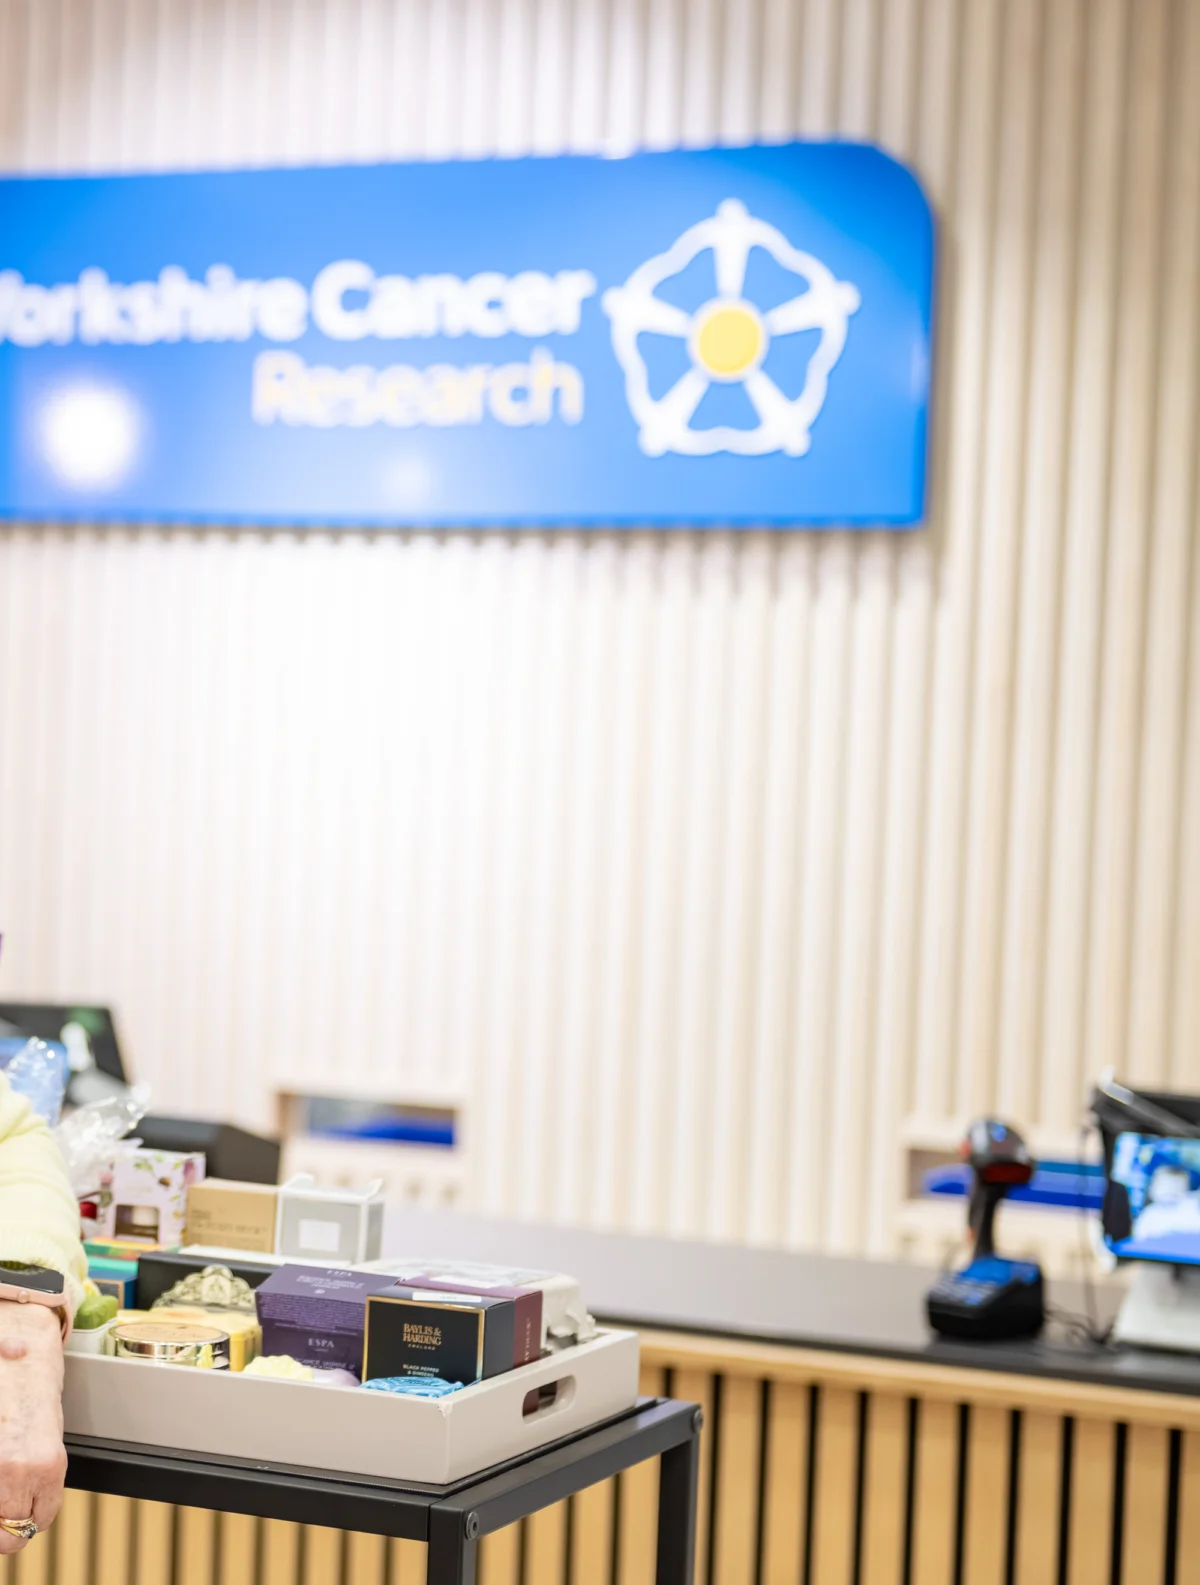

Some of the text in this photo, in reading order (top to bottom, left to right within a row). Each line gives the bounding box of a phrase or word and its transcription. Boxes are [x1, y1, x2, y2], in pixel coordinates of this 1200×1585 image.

[311, 259, 596, 340] Cancer
[252, 345, 584, 428] Research
[403, 1323, 442, 1336] BAYLIS &
[308, 1338, 334, 1348] ESPA
[403, 1333, 442, 1346] HARDING
